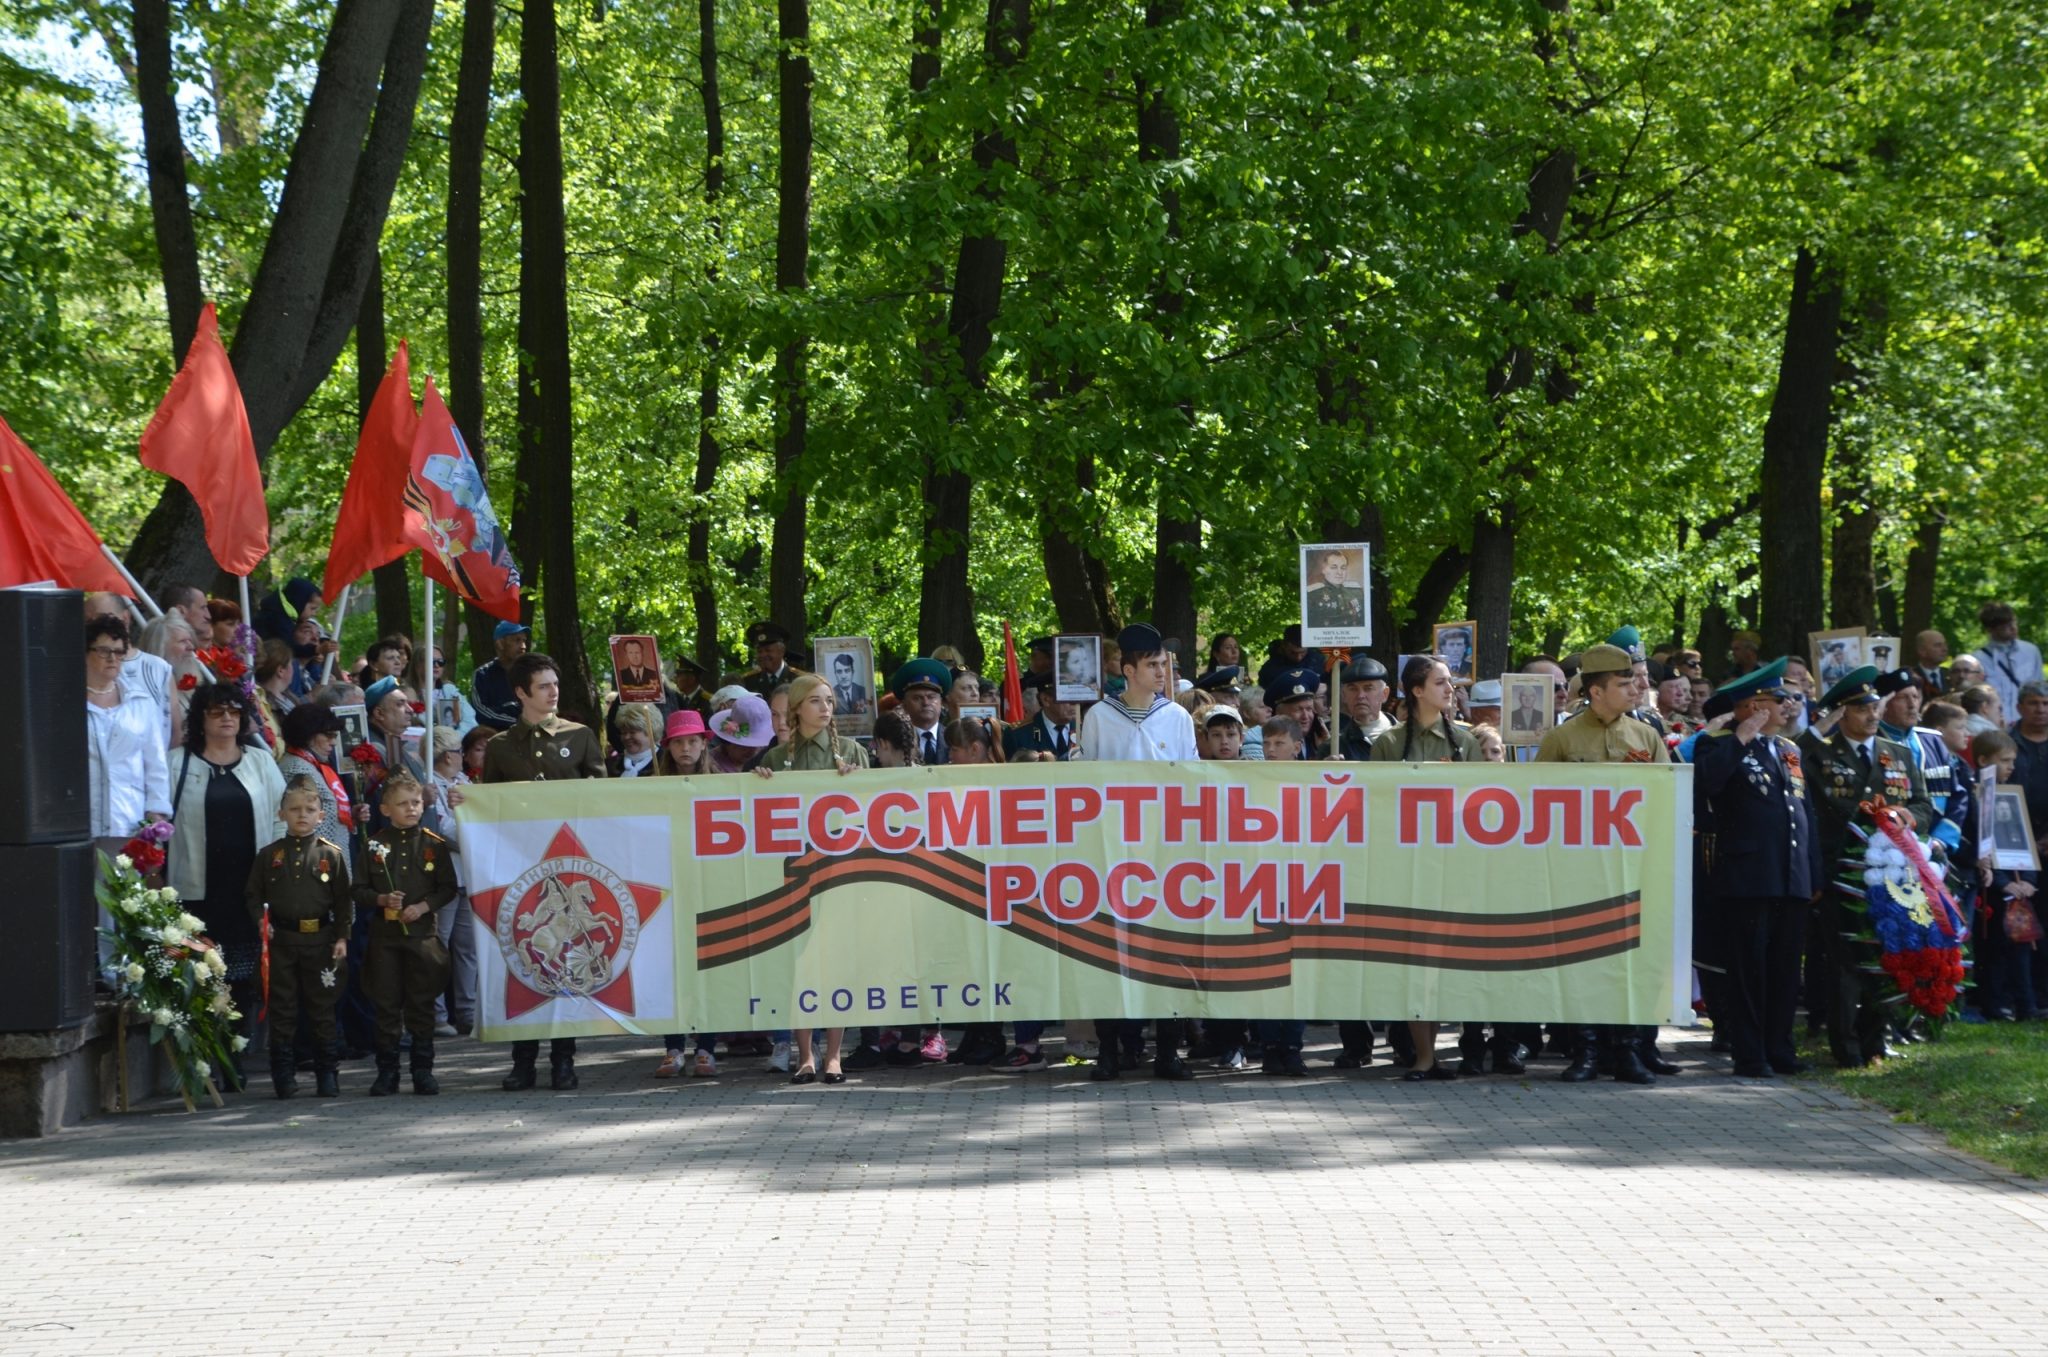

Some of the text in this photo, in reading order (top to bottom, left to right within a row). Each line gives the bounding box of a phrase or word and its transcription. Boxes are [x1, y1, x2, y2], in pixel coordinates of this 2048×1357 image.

[693, 772, 1645, 857] БЕССМЕРТНЫЙ ПОЛК
[498, 858, 638, 957] БЕССМЕРТНЫЙ ПОЛК РОССИИ
[989, 859, 1345, 924] РОССИИ
[748, 982, 1013, 1016] г. СОВЕТСК
